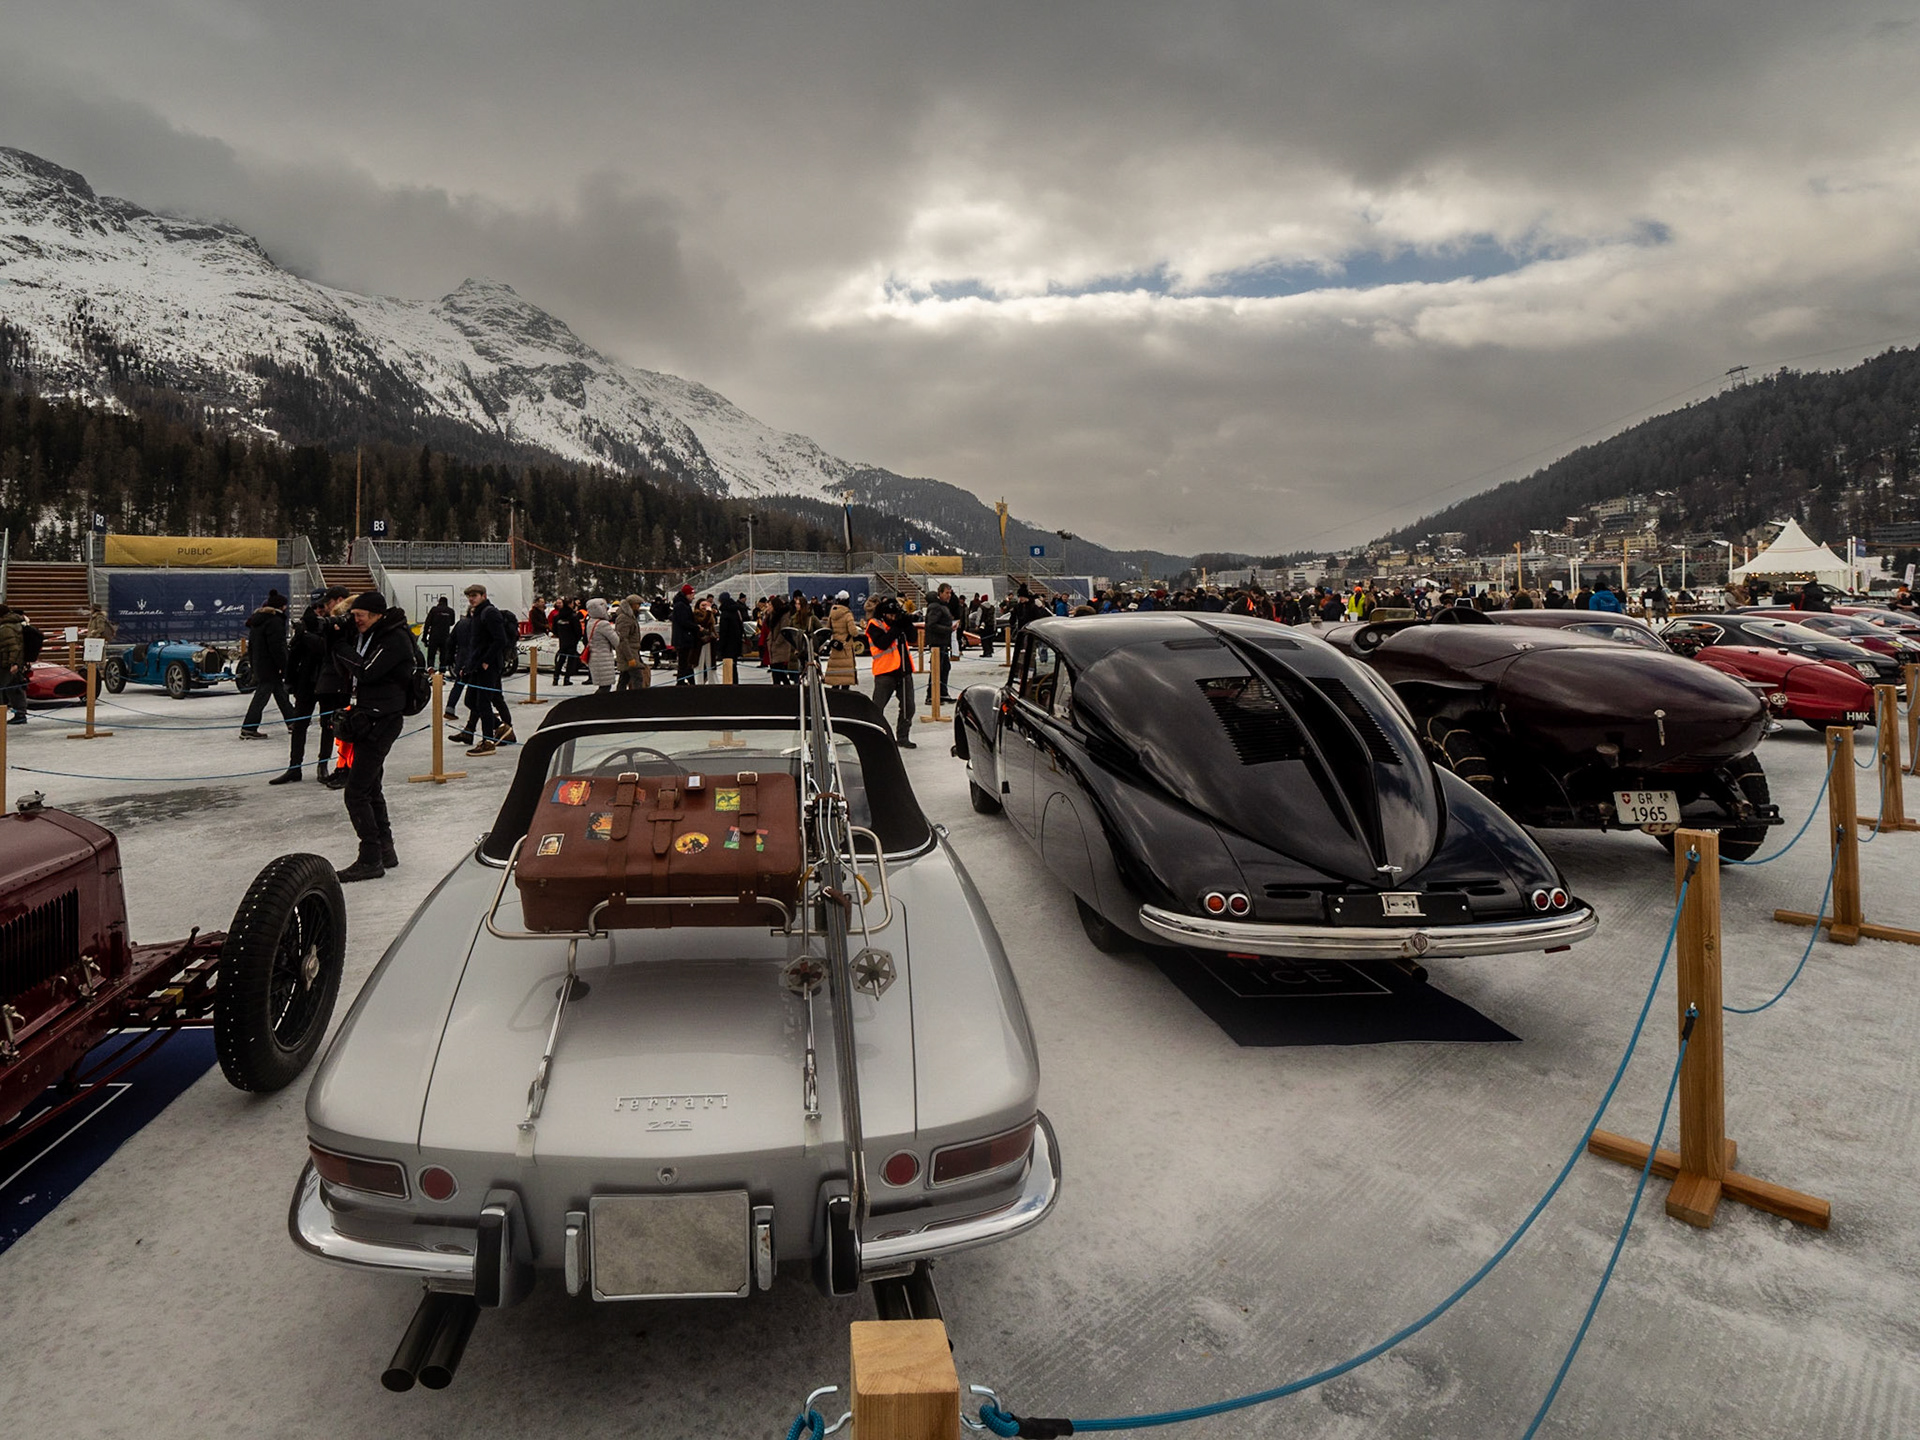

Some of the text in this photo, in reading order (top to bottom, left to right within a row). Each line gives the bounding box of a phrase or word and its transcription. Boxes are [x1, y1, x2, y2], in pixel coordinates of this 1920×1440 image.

[95, 513, 105, 527] B2
[373, 520, 385, 531] B3
[177, 547, 213, 556] PUBLIC
[1771, 694, 1787, 703] GB
[1846, 712, 1870, 721] HMK
[1637, 792, 1653, 805] GR
[1631, 806, 1668, 822] 1965
[1252, 968, 1343, 985] ICE
[614, 1093, 728, 1112] Ferrari
